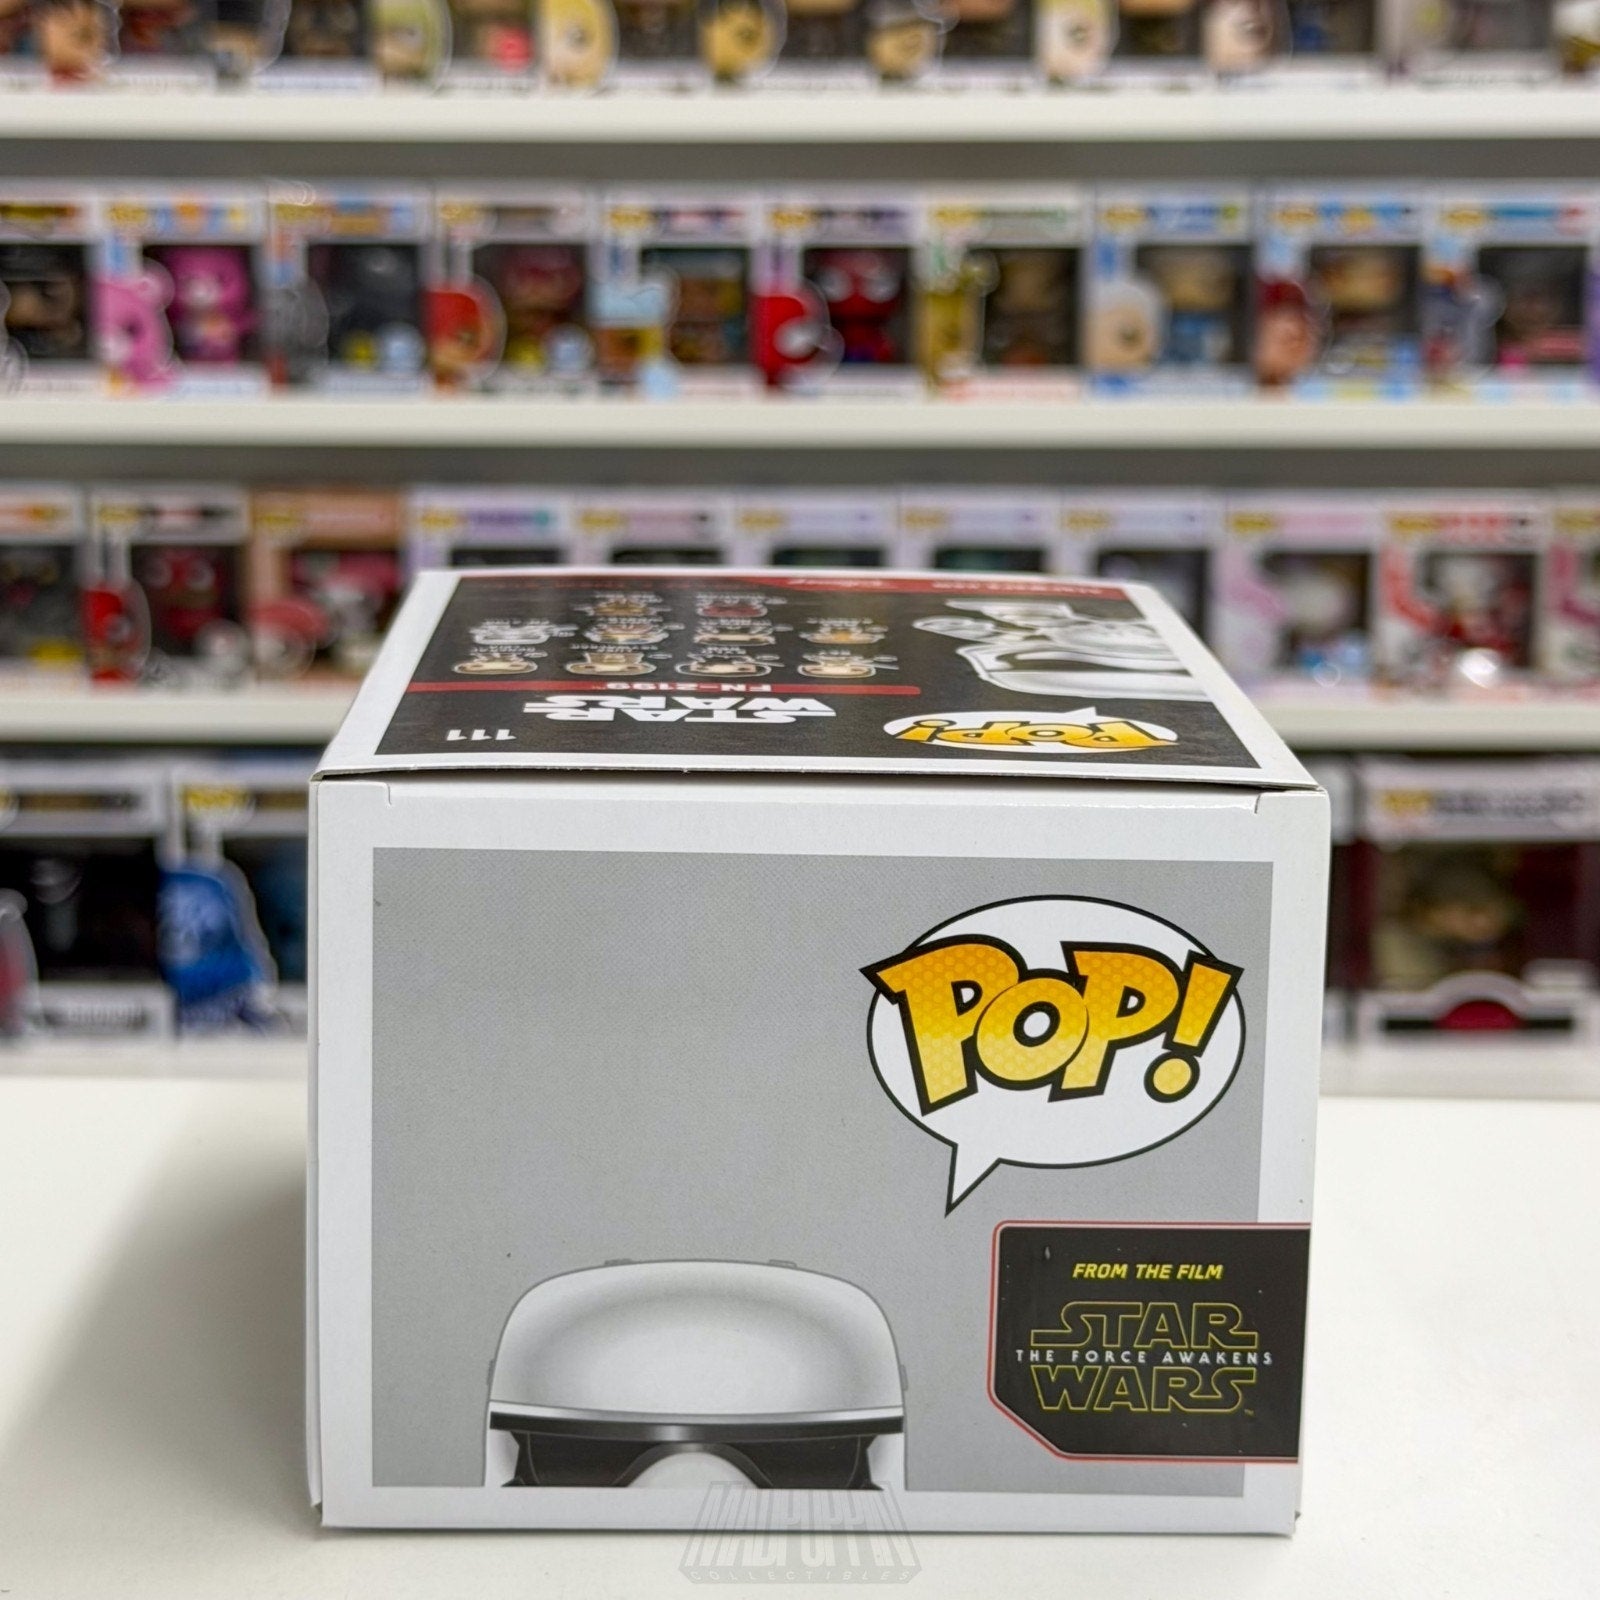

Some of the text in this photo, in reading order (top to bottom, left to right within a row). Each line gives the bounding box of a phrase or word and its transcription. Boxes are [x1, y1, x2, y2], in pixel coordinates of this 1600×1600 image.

[524, 695, 835, 711] WARS
[523, 707, 836, 723] STAR
[446, 728, 517, 741] 111
[893, 718, 1180, 748] POP!
[860, 934, 1244, 1116] POP!
[1072, 1263, 1224, 1280] FROM THE FILM
[1030, 1301, 1258, 1349] STAR
[1015, 1349, 1273, 1365] THE FORCE AWAKENS
[1030, 1364, 1258, 1413] WARS
